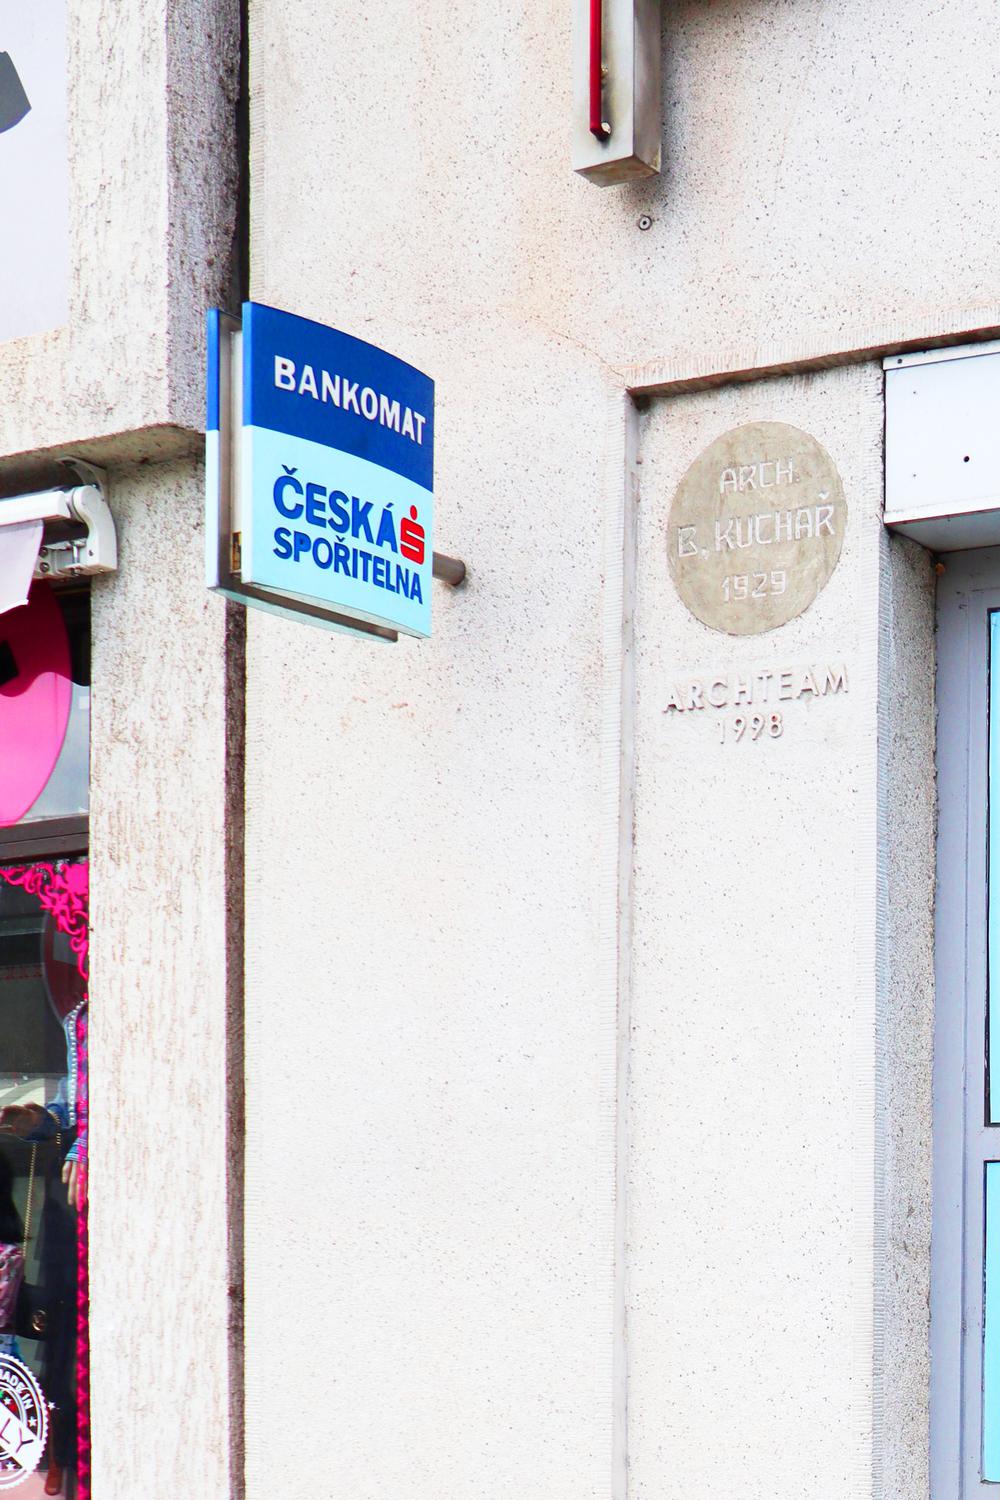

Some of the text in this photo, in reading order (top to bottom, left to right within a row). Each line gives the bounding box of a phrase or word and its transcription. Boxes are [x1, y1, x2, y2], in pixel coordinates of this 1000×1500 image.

[274, 355, 426, 445] BANKOMAT
[719, 457, 800, 494] ARCH.
[273, 464, 399, 554] ČESKÁ
[715, 492, 836, 552] KUCHAŘ
[273, 527, 424, 604] SPOŘITELNA
[722, 570, 787, 602] 1929
[663, 663, 849, 714] ARCHTEAM
[717, 712, 785, 745] 1998
